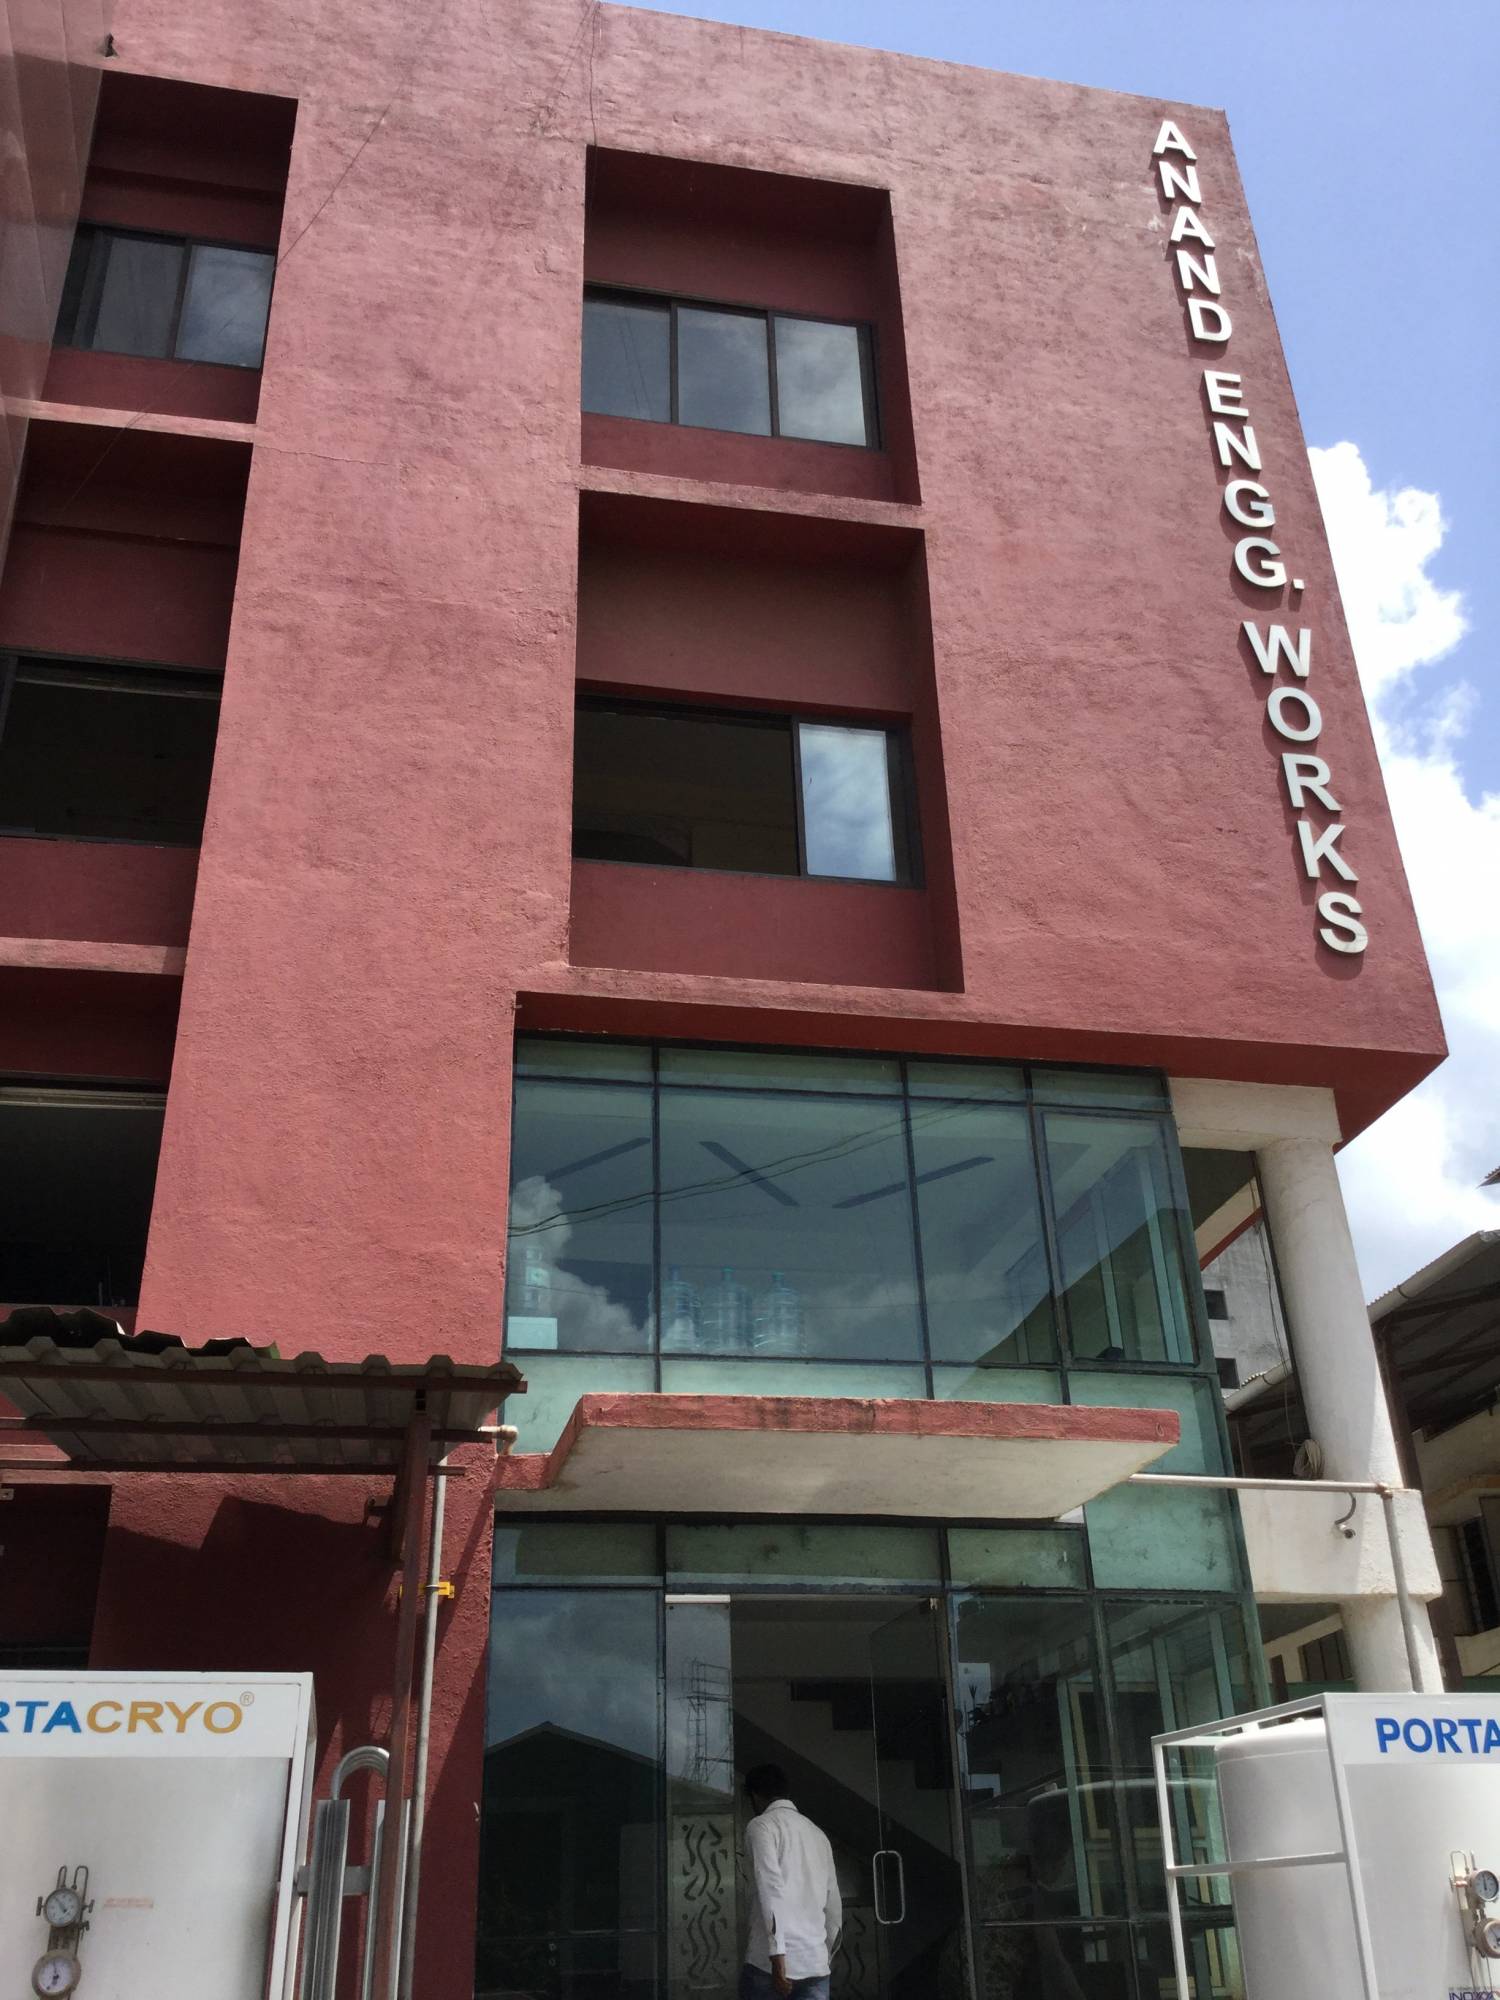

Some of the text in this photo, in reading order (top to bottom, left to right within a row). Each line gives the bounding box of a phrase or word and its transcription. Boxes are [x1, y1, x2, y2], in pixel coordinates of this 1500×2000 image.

[1152, 120, 1368, 954] ANAND ENGG. WORKS
